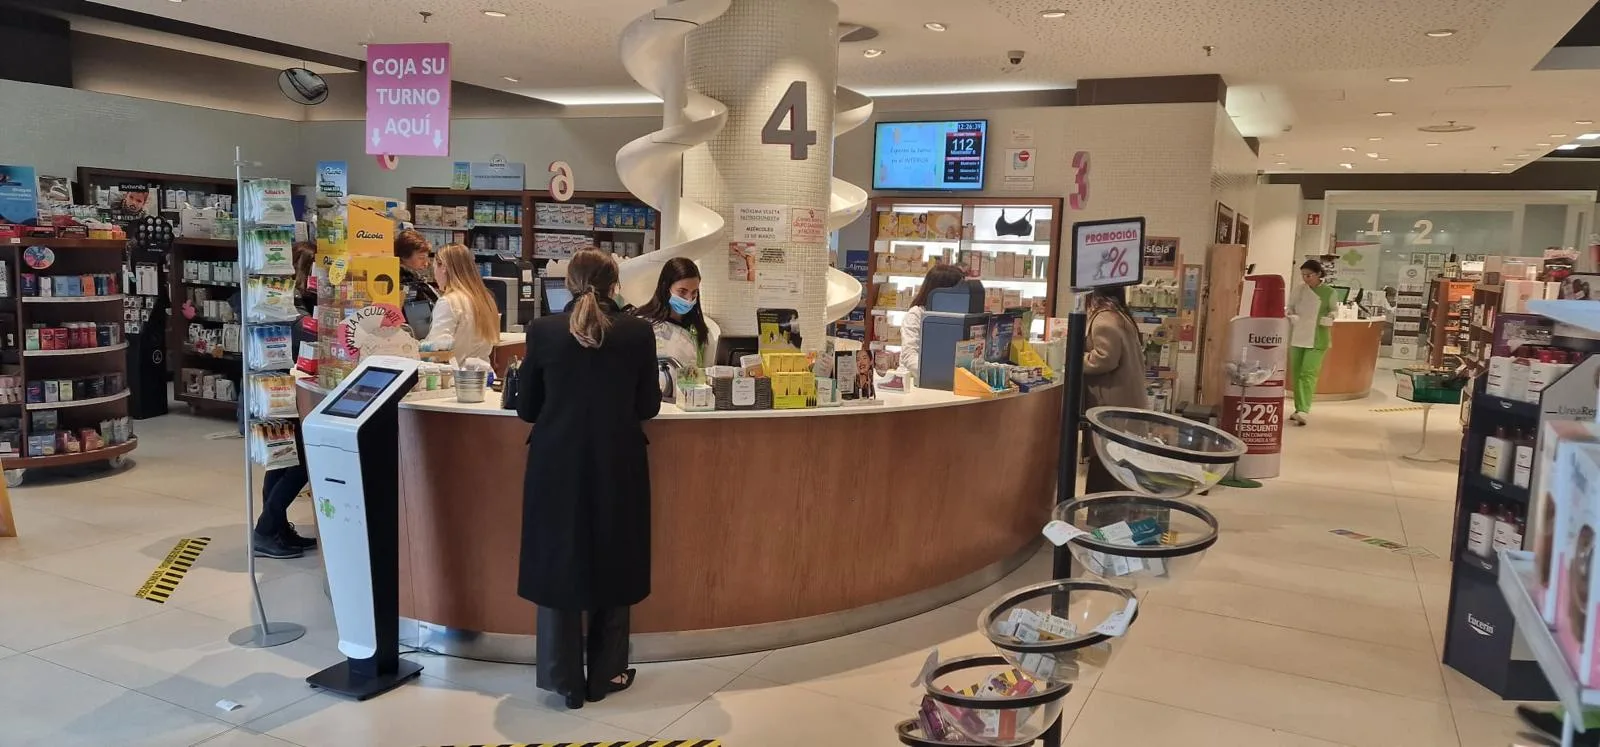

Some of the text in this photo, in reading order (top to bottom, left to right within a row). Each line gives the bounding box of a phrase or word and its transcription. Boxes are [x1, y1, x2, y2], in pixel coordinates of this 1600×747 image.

[373, 57, 445, 79] COJA SU
[375, 88, 440, 105] TURNO
[384, 113, 431, 138] AQUÍ
[761, 80, 817, 160] 4
[952, 138, 974, 151] 112
[1069, 151, 1091, 210] 3
[356, 230, 385, 239] Ricola
[1364, 213, 1383, 236] 1
[1412, 219, 1434, 245] 2
[1085, 229, 1138, 243] PROMOCIÓN
[356, 312, 364, 321] A
[1248, 333, 1283, 344] Eucerin
[1236, 403, 1279, 424] 22%
[1467, 613, 1494, 634] Eucerin
